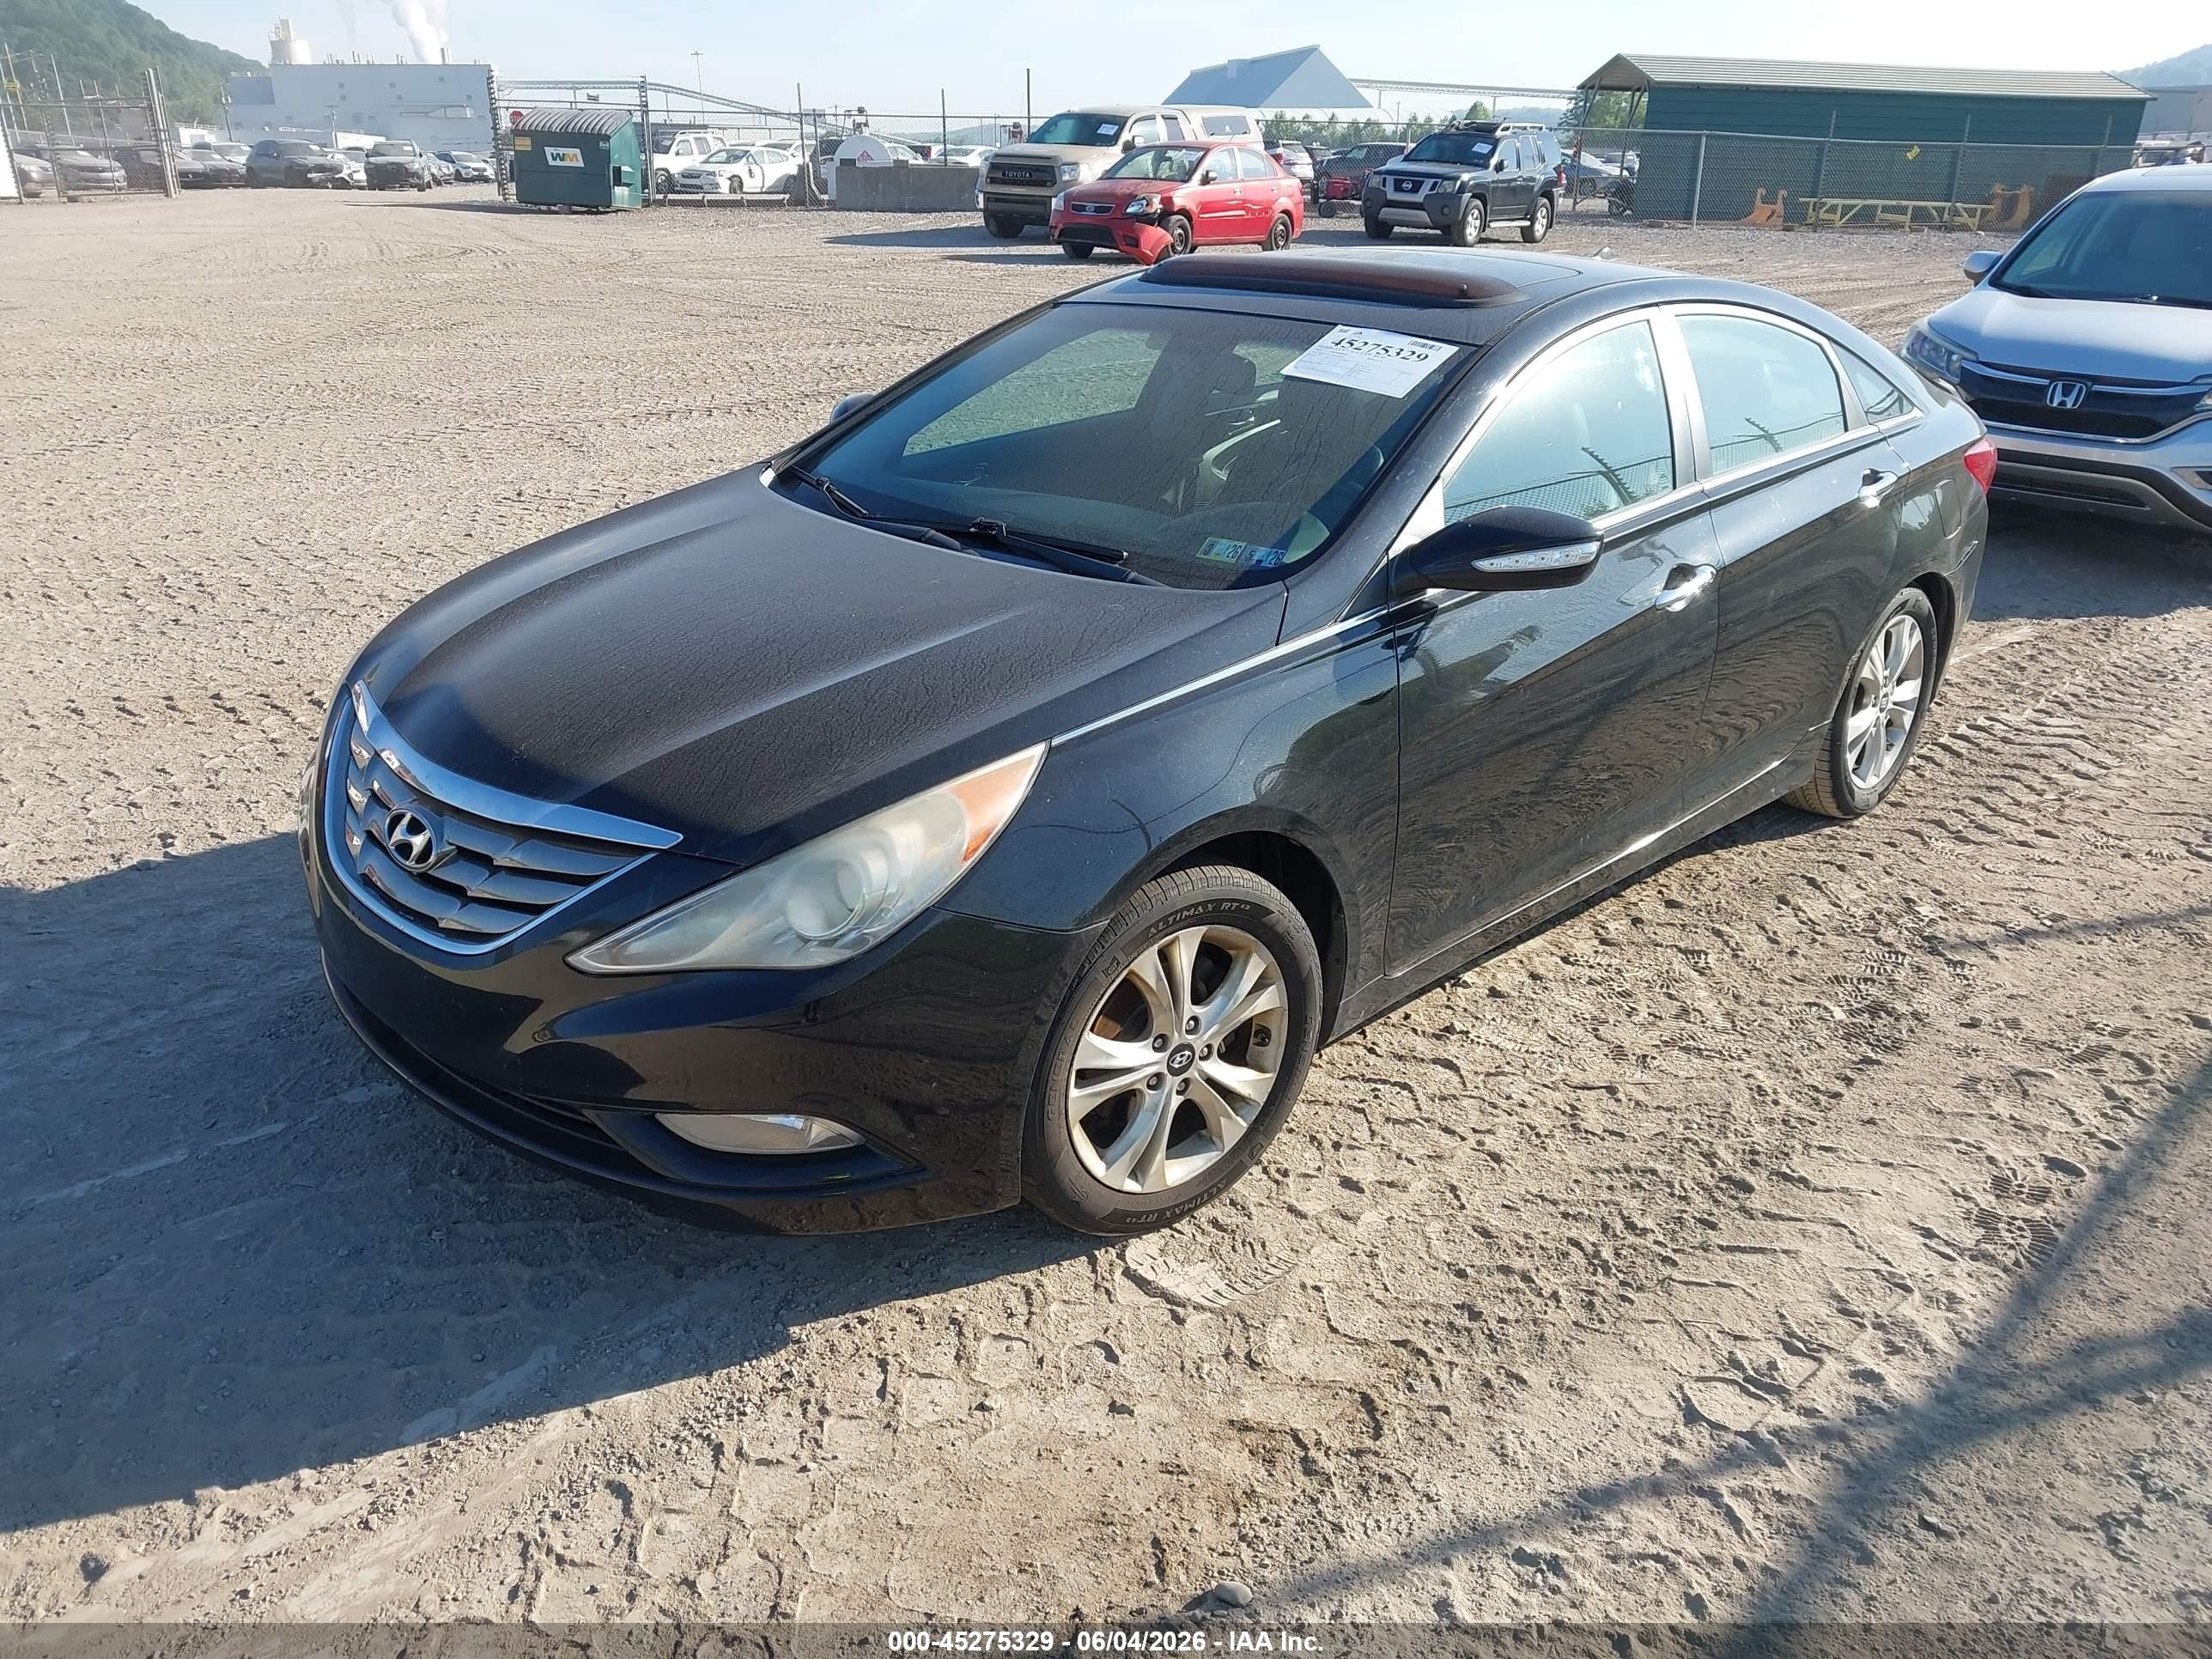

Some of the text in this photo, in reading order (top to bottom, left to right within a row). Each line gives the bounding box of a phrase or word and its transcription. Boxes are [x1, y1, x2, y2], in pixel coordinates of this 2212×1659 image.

[550, 152, 578, 162] WM
[1331, 337, 1430, 362] 45275329
[1147, 902, 1217, 938] ALTIMAX
[1163, 1179, 1227, 1219] ALTIMAX
